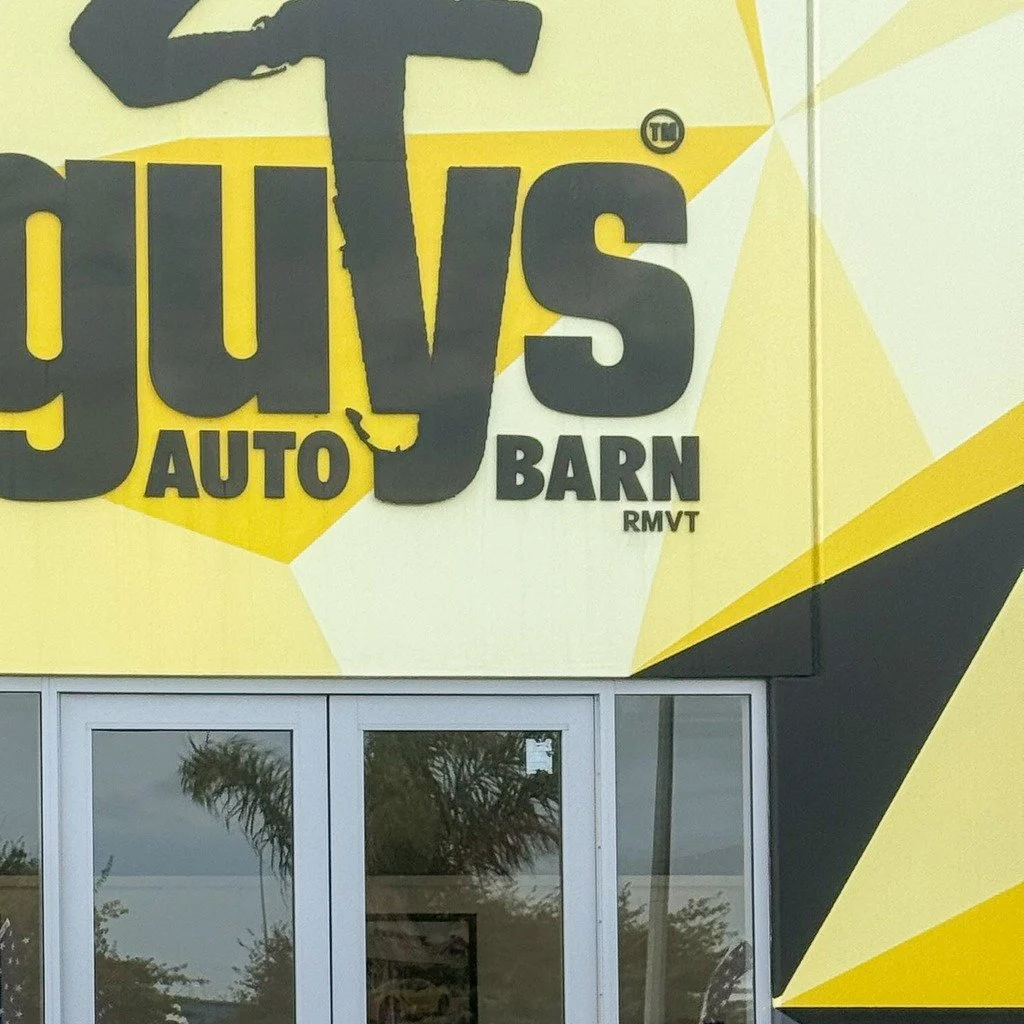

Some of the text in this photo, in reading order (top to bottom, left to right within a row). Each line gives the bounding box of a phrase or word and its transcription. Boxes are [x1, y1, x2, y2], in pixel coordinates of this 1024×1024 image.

[143, 429, 701, 502] AUTO BARN
[623, 510, 700, 533] RMVT
